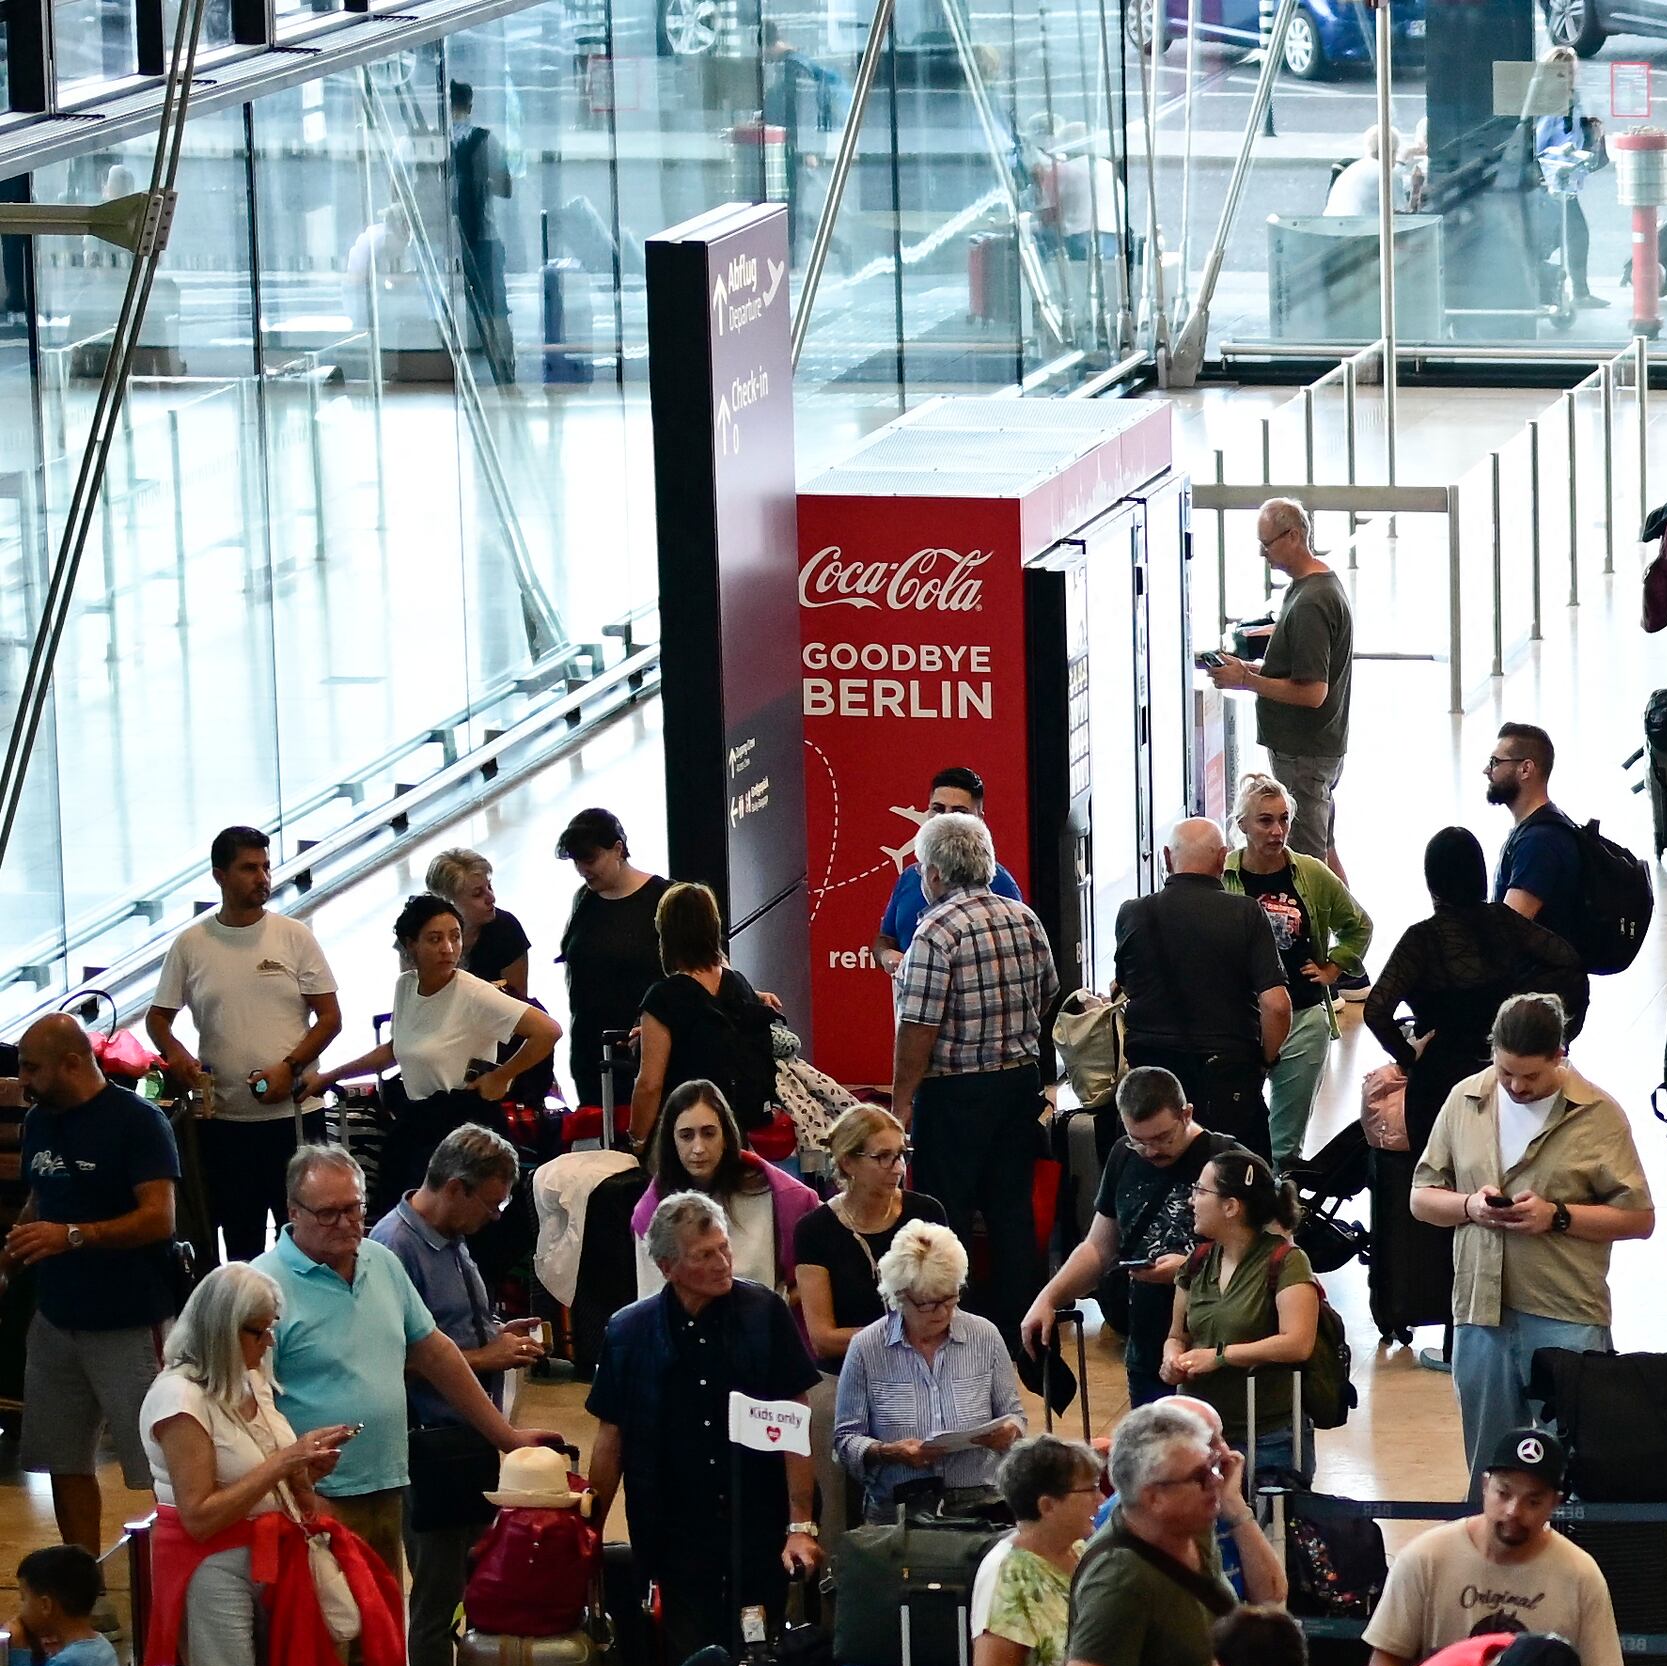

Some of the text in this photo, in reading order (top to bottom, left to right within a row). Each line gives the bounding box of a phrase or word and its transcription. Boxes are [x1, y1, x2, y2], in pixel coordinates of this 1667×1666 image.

[728, 254, 757, 294] Abflug
[729, 297, 762, 334] Departure
[731, 365, 768, 413] Check-in
[798, 546, 994, 611] Coca-Cola
[802, 642, 991, 672] GOODBYE
[803, 678, 992, 719] BERLIN
[749, 1406, 803, 1429] Kids only
[1461, 1584, 1545, 1610] Original
